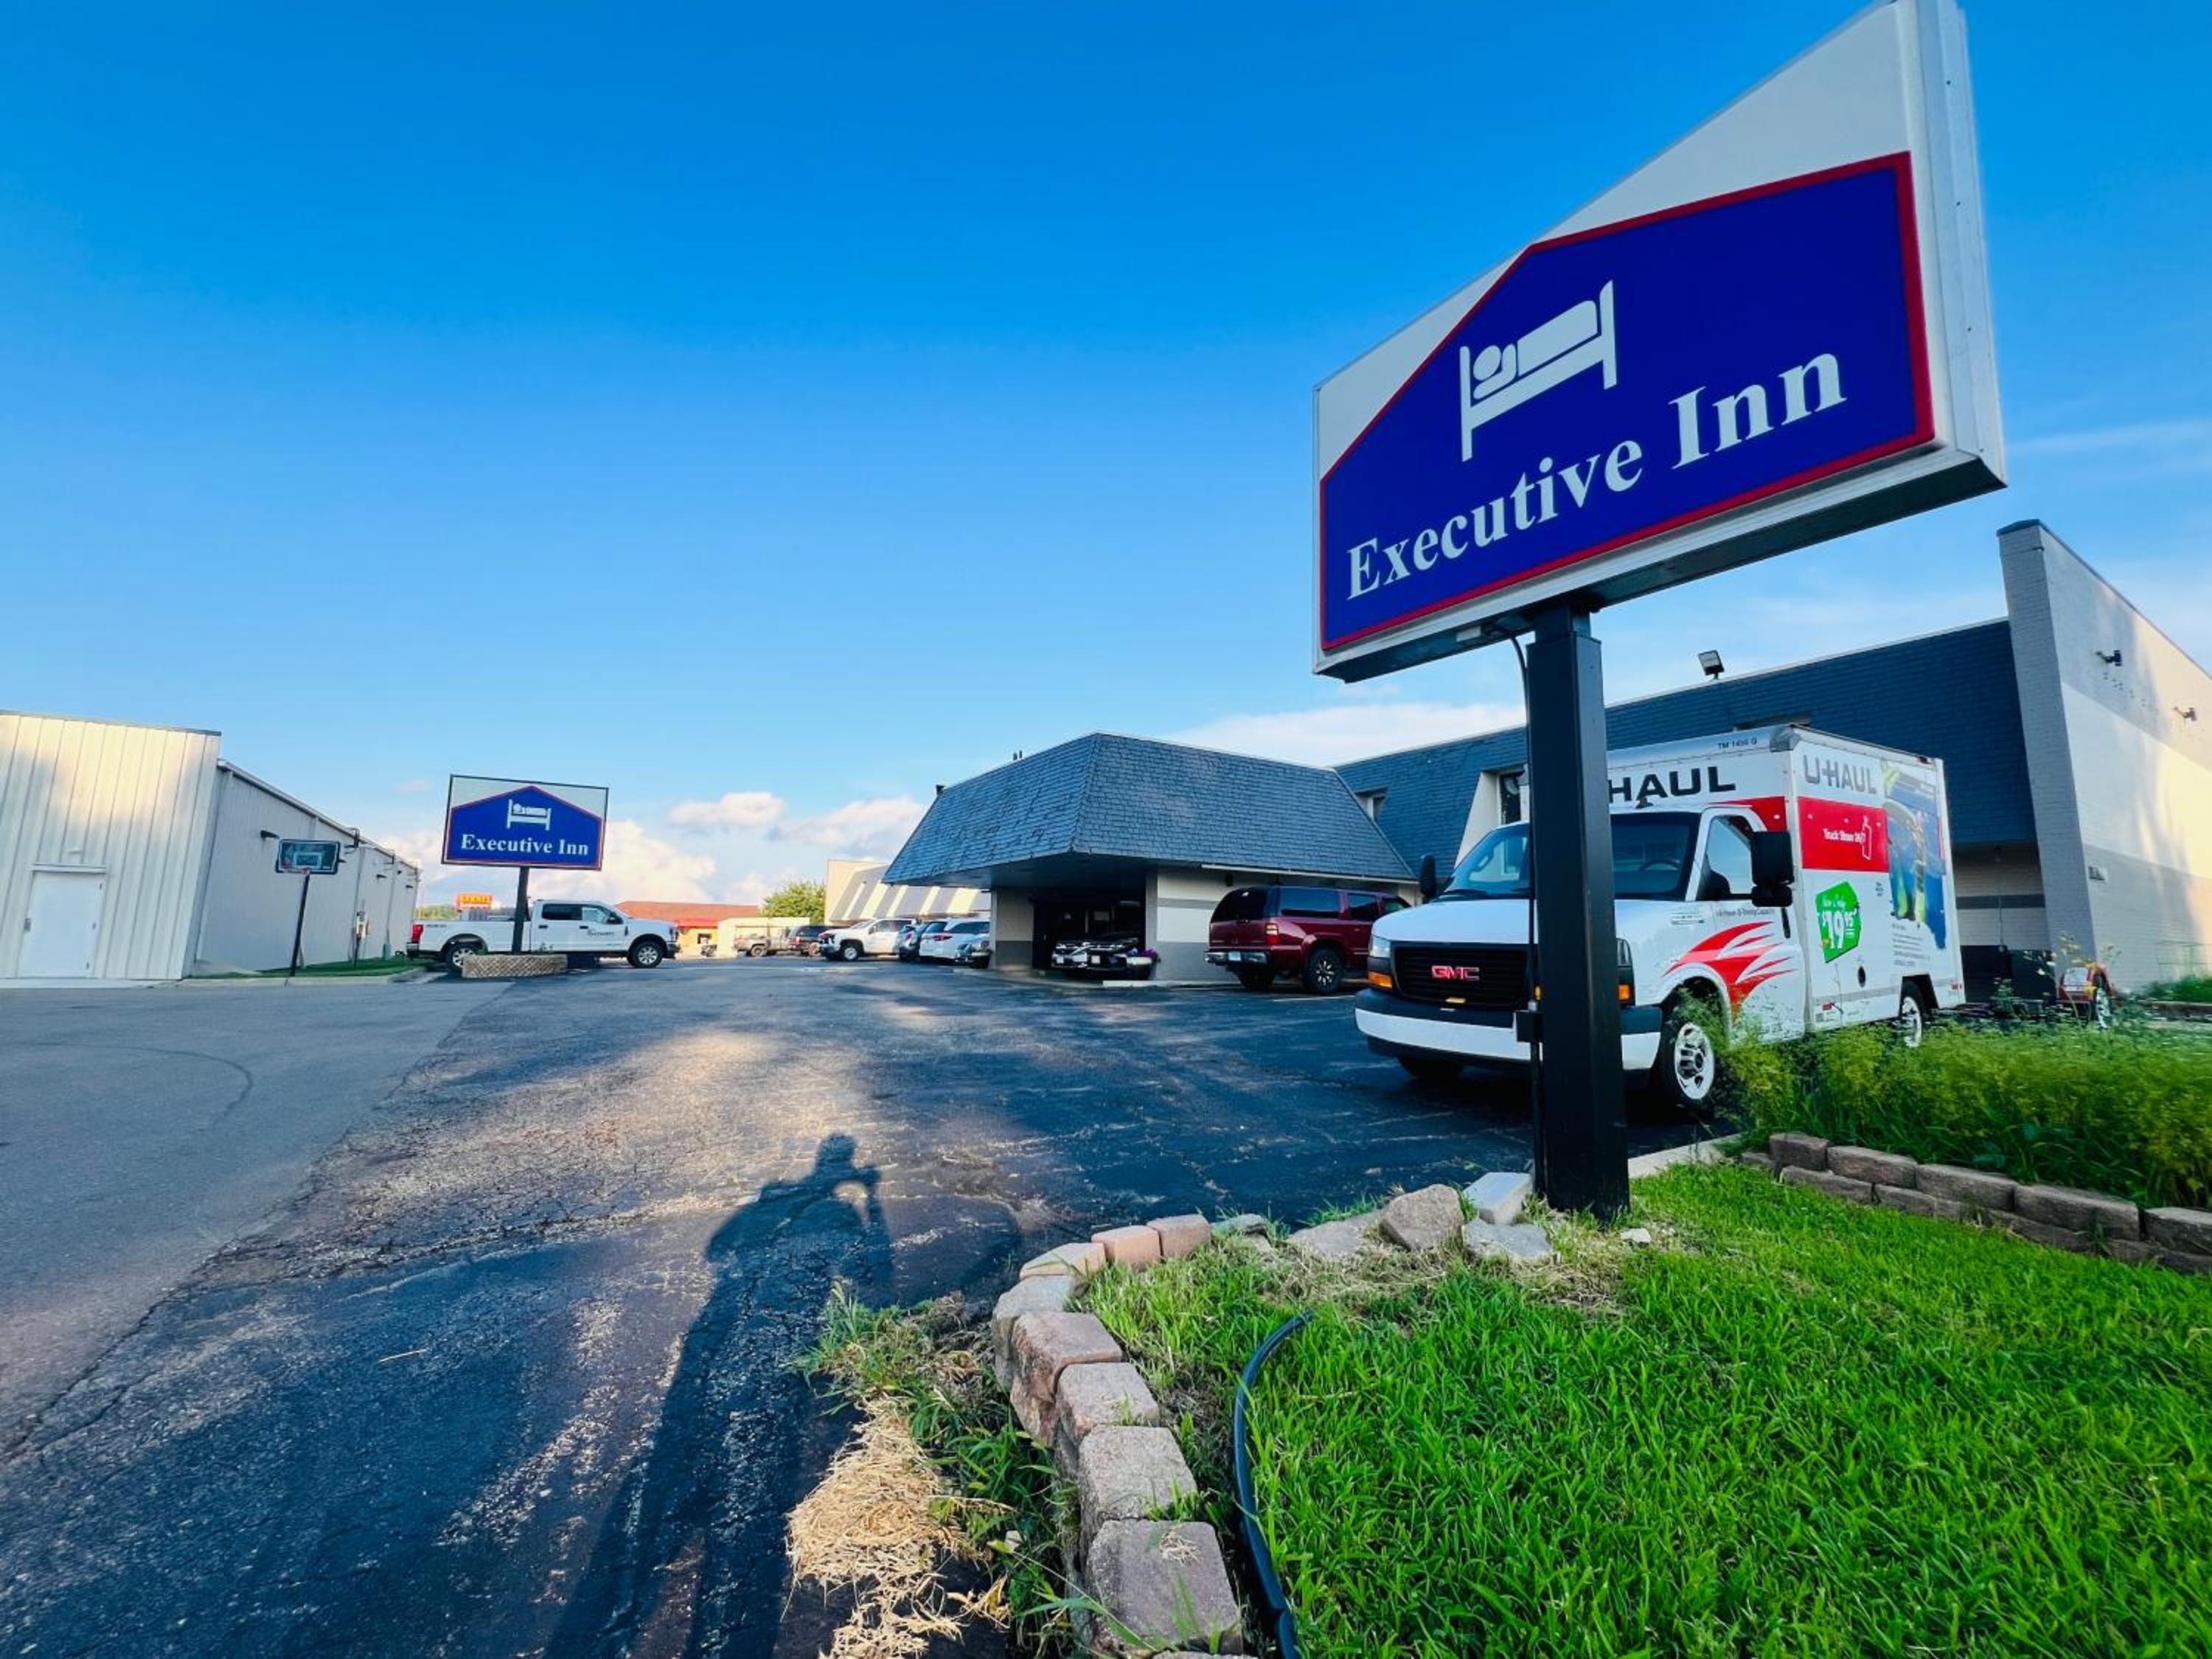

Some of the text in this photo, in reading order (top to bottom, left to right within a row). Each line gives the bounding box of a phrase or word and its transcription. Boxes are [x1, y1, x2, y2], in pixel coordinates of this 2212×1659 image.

[1346, 353, 1848, 601] Executive Inn
[1803, 754, 1877, 794] U-HAUL
[461, 833, 590, 856] Executive Inn
[1431, 965, 1480, 981] GMC
